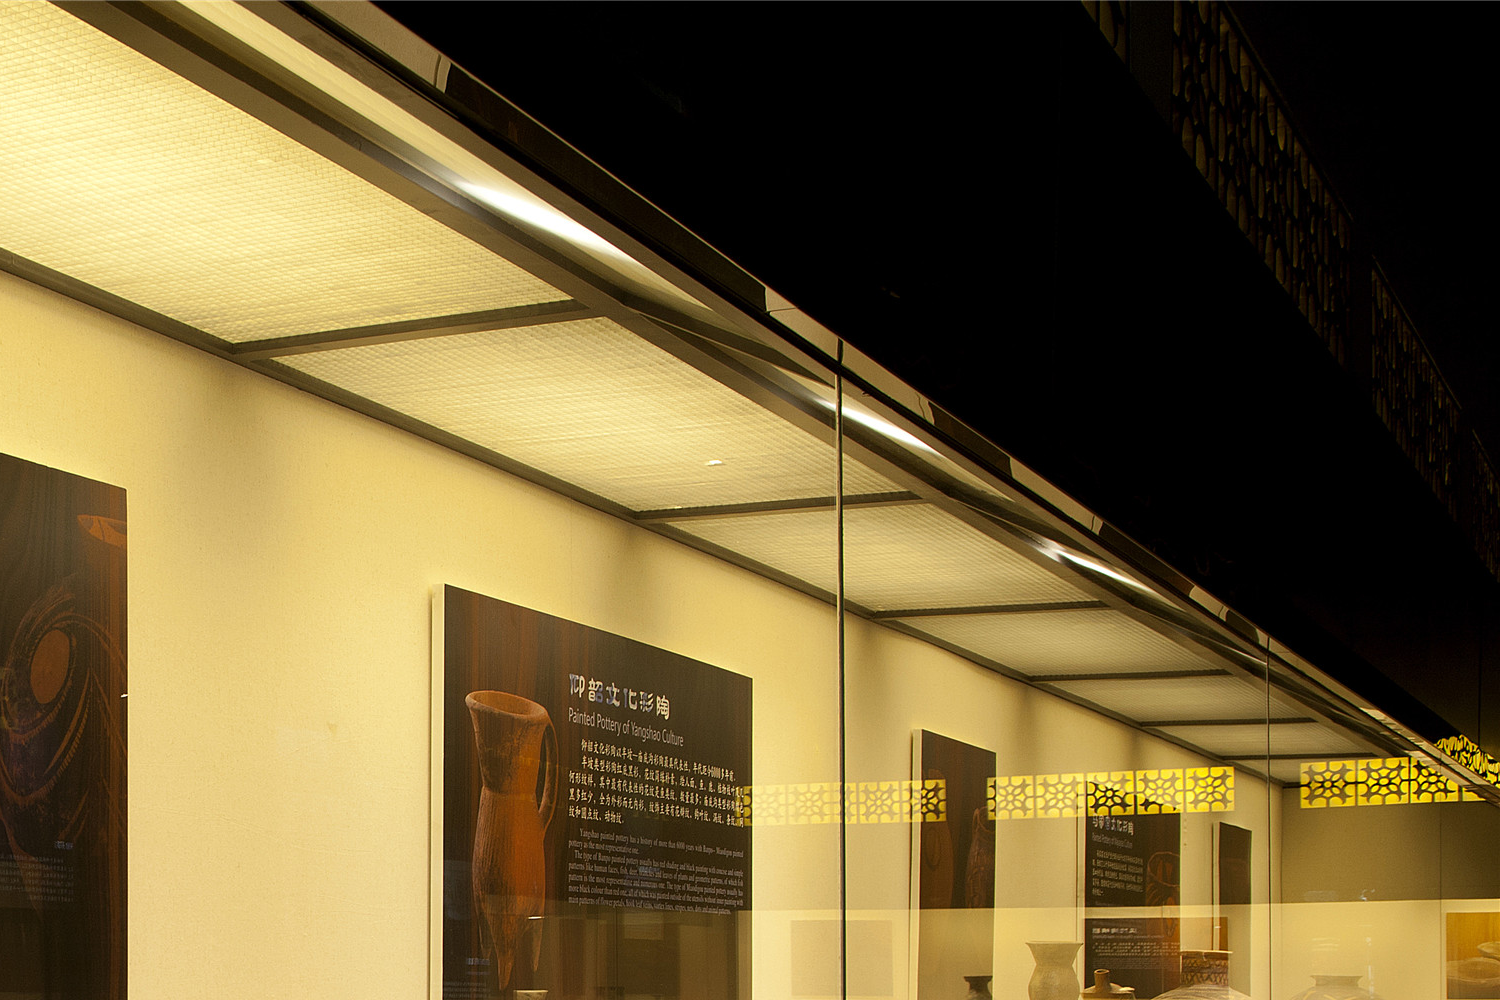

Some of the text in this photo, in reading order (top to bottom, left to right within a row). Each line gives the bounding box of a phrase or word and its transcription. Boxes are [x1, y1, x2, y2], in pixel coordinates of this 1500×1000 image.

[568, 707, 684, 747] Painted Pottery of Yangshao Culture
